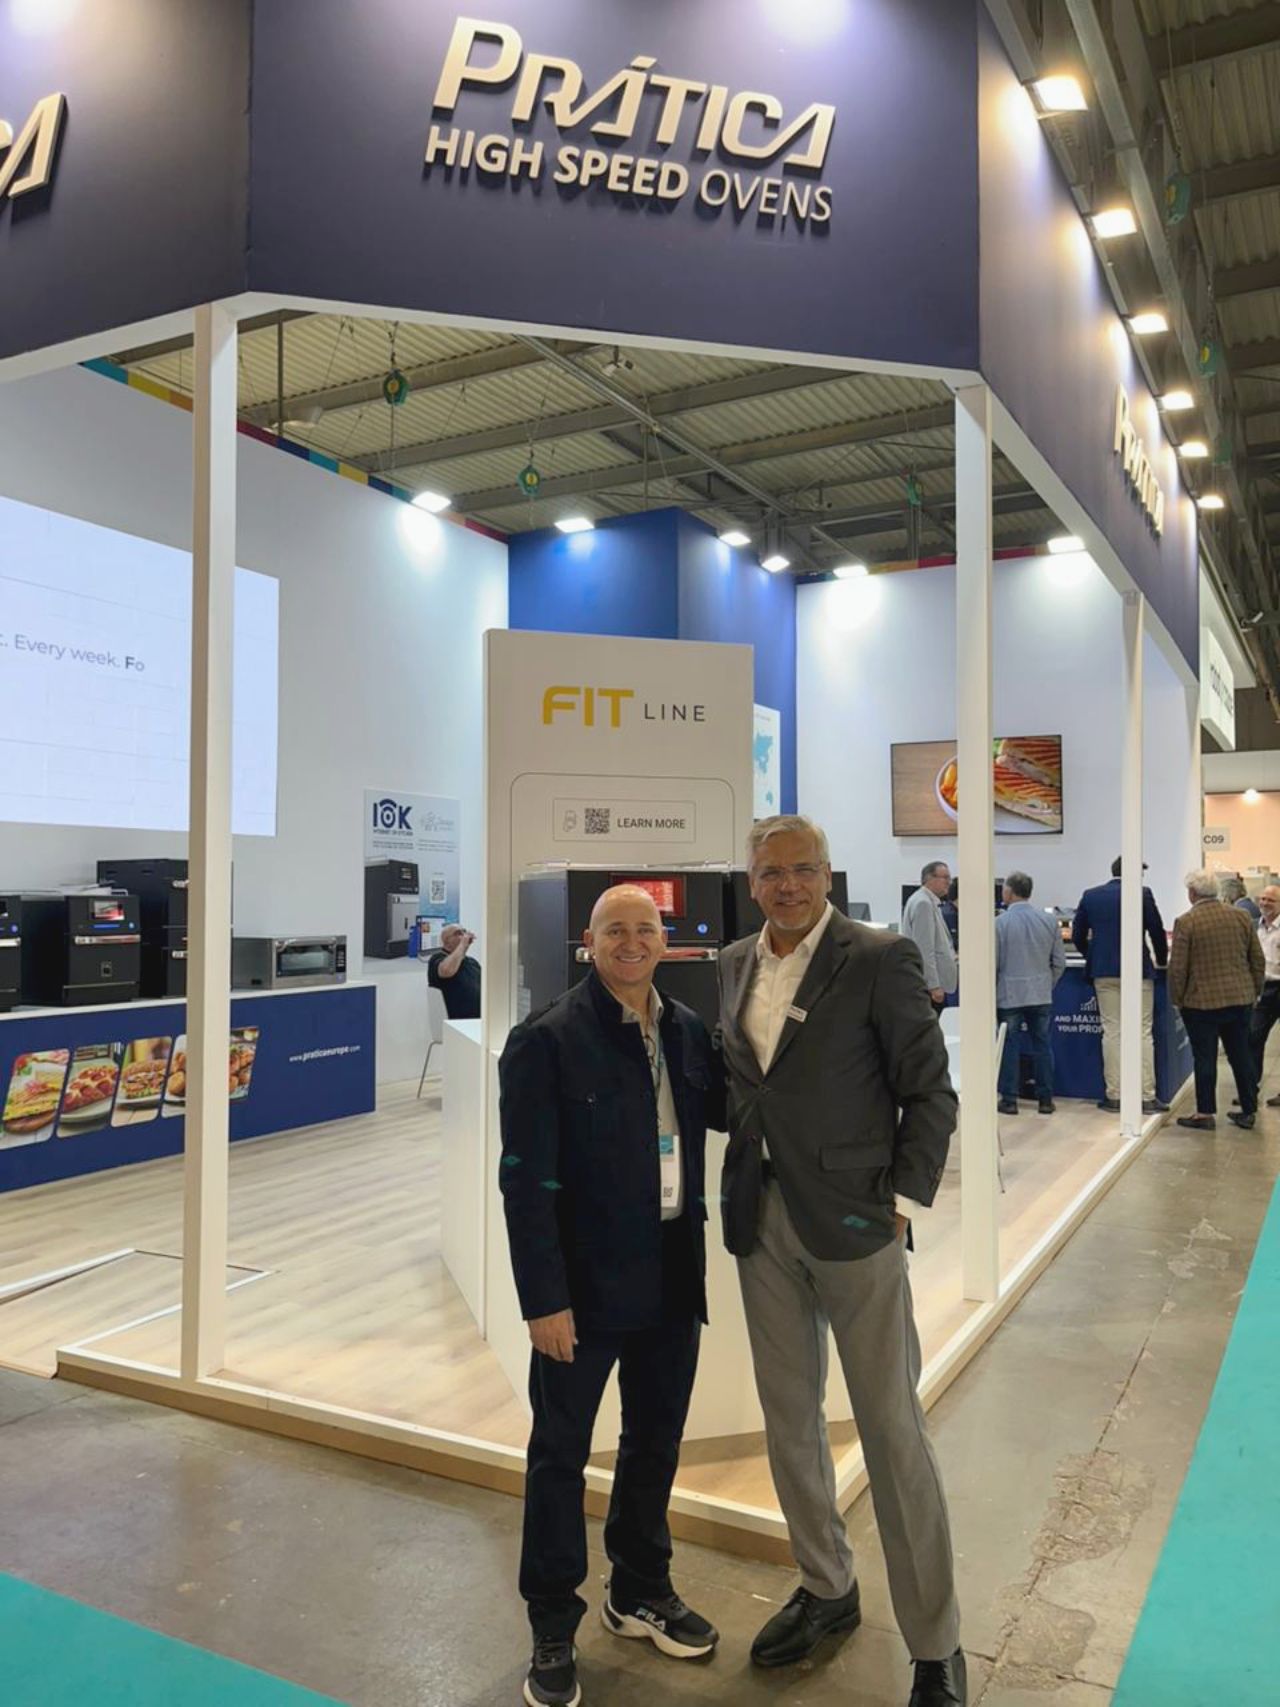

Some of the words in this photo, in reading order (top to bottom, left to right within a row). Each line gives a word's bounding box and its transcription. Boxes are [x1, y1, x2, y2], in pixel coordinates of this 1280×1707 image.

[432, 16, 836, 169] PRÁTICA
[0, 92, 62, 198] A
[424, 125, 543, 179] HIGH
[553, 145, 690, 200] SPEED
[700, 169, 833, 222] OVENS
[14, 633, 67, 660] Every
[70, 647, 121, 668] week.
[125, 656, 145, 672] Fo
[542, 686, 634, 728] FIT
[643, 703, 706, 722] LINE
[617, 818, 653, 829] LEARN
[655, 818, 686, 829] MORE
[1203, 834, 1225, 845] C09
[635, 1607, 666, 1631] FILA
